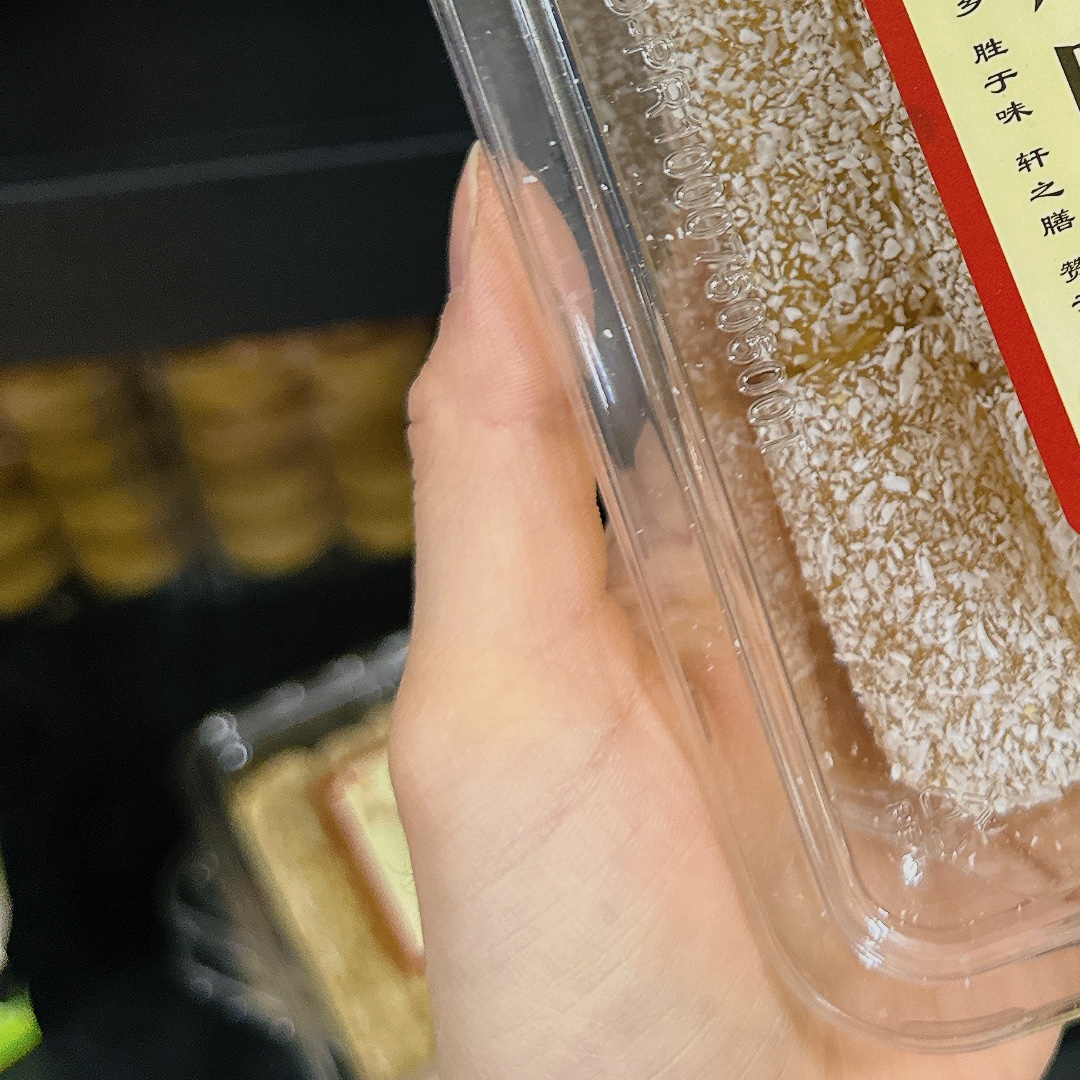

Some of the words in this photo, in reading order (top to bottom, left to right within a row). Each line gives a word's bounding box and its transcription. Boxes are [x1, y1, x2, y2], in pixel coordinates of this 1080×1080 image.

[973, 37, 1034, 125] 胜于味
[1015, 147, 1076, 237] 轩之膳
